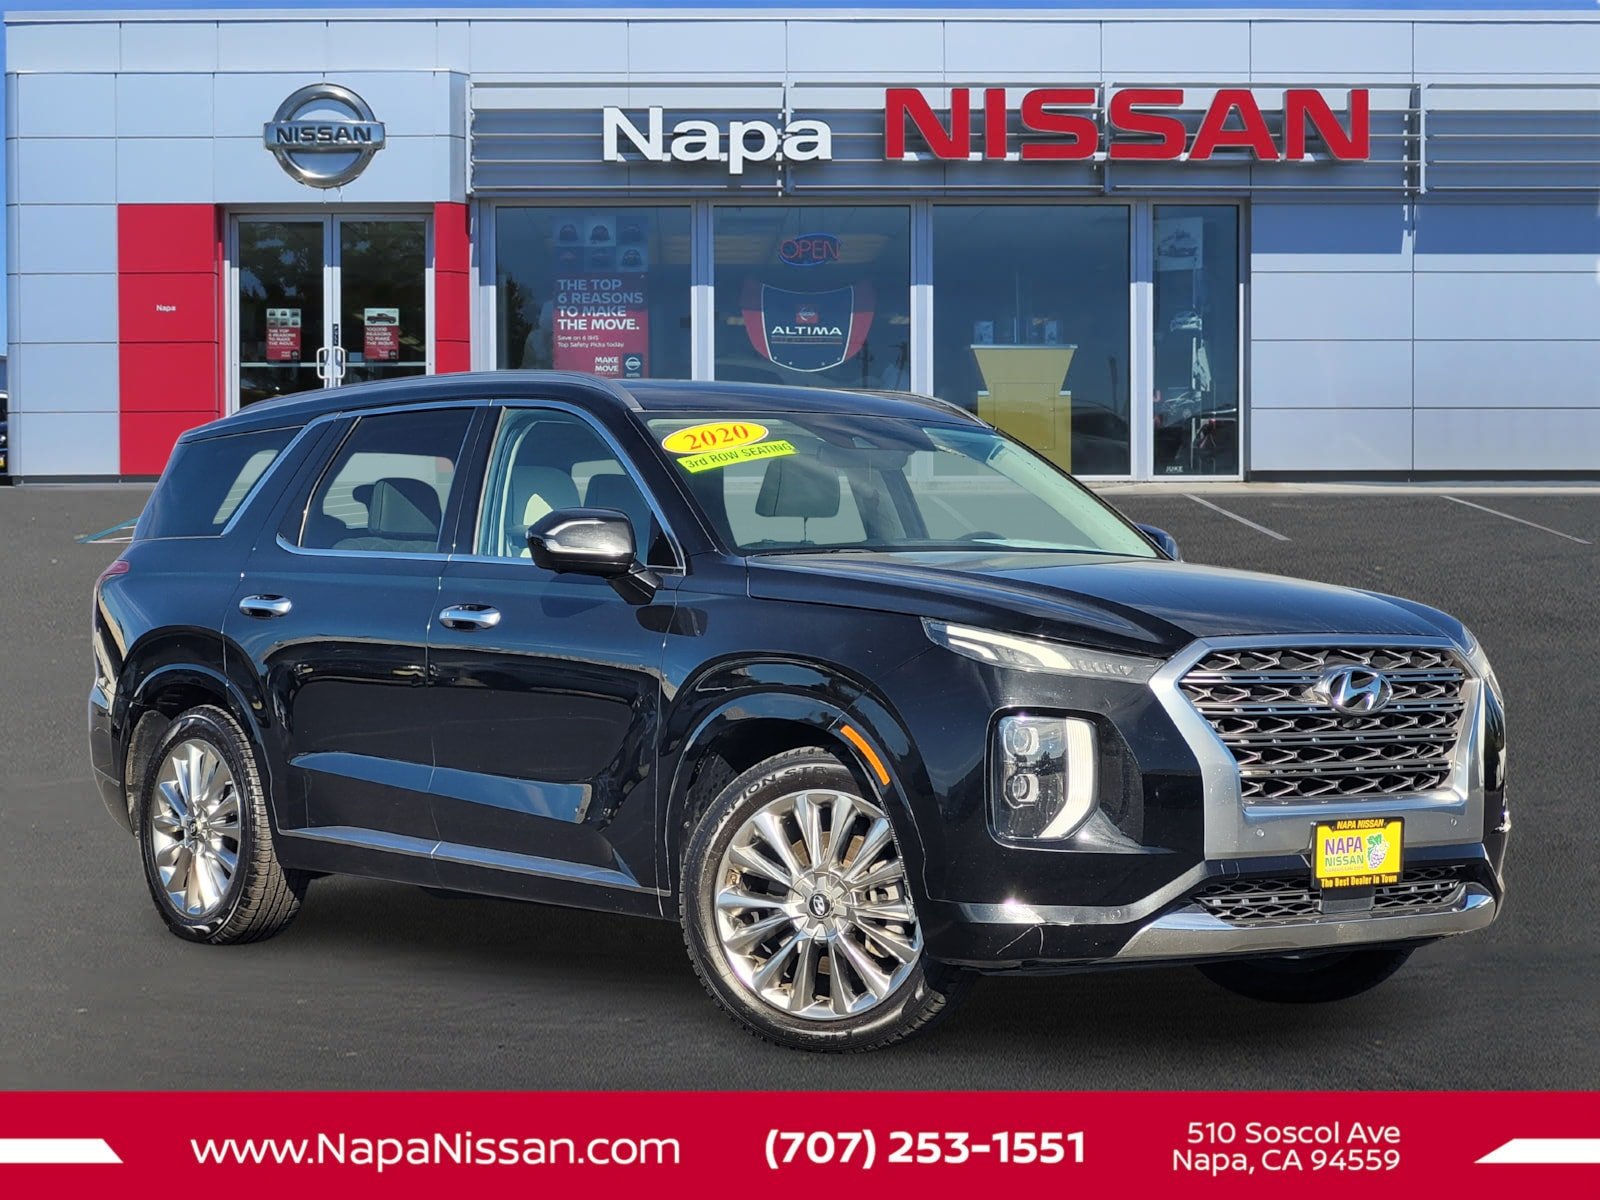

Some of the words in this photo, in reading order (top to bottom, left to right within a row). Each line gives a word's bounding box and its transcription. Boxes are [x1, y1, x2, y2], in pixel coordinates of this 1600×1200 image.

[276, 126, 372, 142] NISSAN
[603, 106, 832, 174] Napa
[887, 90, 1368, 160] NISSAN
[780, 240, 841, 260] OPEN
[557, 279, 587, 291] THE
[591, 279, 622, 291] TOP
[558, 292, 568, 304] 6
[571, 292, 643, 304] REASONS
[156, 304, 176, 312] Napa
[557, 305, 578, 317] TO
[582, 306, 627, 317] MAKE
[557, 319, 587, 330] THE
[591, 319, 640, 330] MOVE.
[771, 326, 842, 336] ALTIMA
[683, 424, 749, 450] 2020
[686, 458, 708, 468] 3rd
[709, 451, 740, 463] ROW
[741, 443, 792, 457] SEATING
[1337, 820, 1357, 830] NAPA
[1357, 819, 1384, 829] NISSAN
[1325, 836, 1363, 855] NAPA
[1325, 855, 1364, 867] NISSAN
[1321, 878, 1333, 888] The
[1334, 877, 1350, 887] Best
[1351, 875, 1372, 886] Dealer
[1381, 874, 1398, 884] Town
